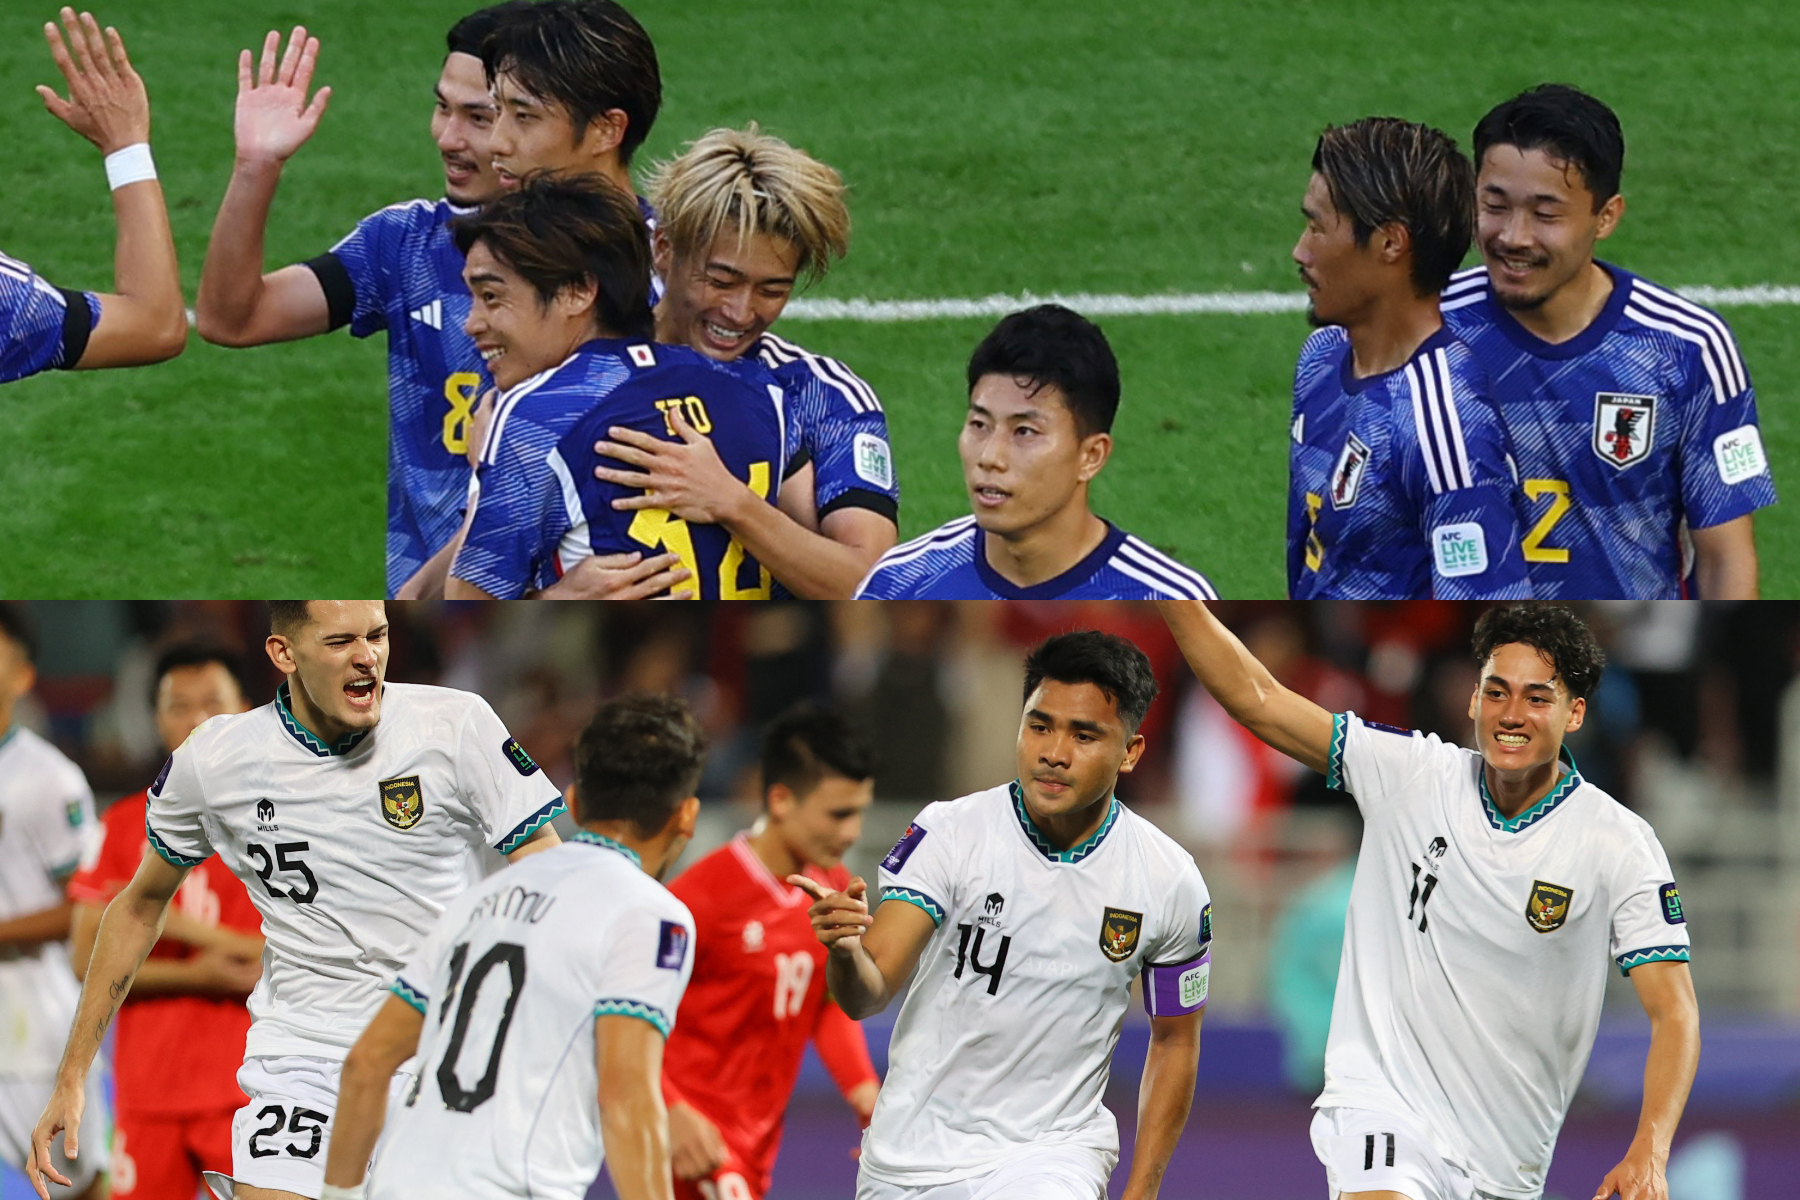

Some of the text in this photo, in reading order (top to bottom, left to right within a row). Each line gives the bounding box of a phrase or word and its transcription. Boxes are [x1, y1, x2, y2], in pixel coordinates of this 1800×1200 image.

[1611, 396, 1642, 405] JAPAN
[443, 371, 481, 454] 8
[655, 395, 712, 436] ITO
[1722, 438, 1740, 451] AFC
[1723, 442, 1754, 465] LIVE
[1521, 478, 1571, 563] 2
[1441, 531, 1462, 542] AFC
[1442, 539, 1477, 556] LIVE
[385, 781, 415, 790] INDONESIA
[257, 824, 279, 833] MILLS
[246, 841, 319, 904] 25
[1407, 861, 1439, 934] 11
[978, 916, 1002, 928] MILLS
[1109, 912, 1138, 922] INDONESIA
[954, 923, 1012, 996] 14
[773, 949, 815, 1021] 19
[1184, 971, 1201, 983] AFC
[1184, 974, 1208, 993] LIVE
[405, 942, 528, 1114] 10
[248, 1104, 330, 1159] 25
[1364, 1131, 1396, 1170] 11
